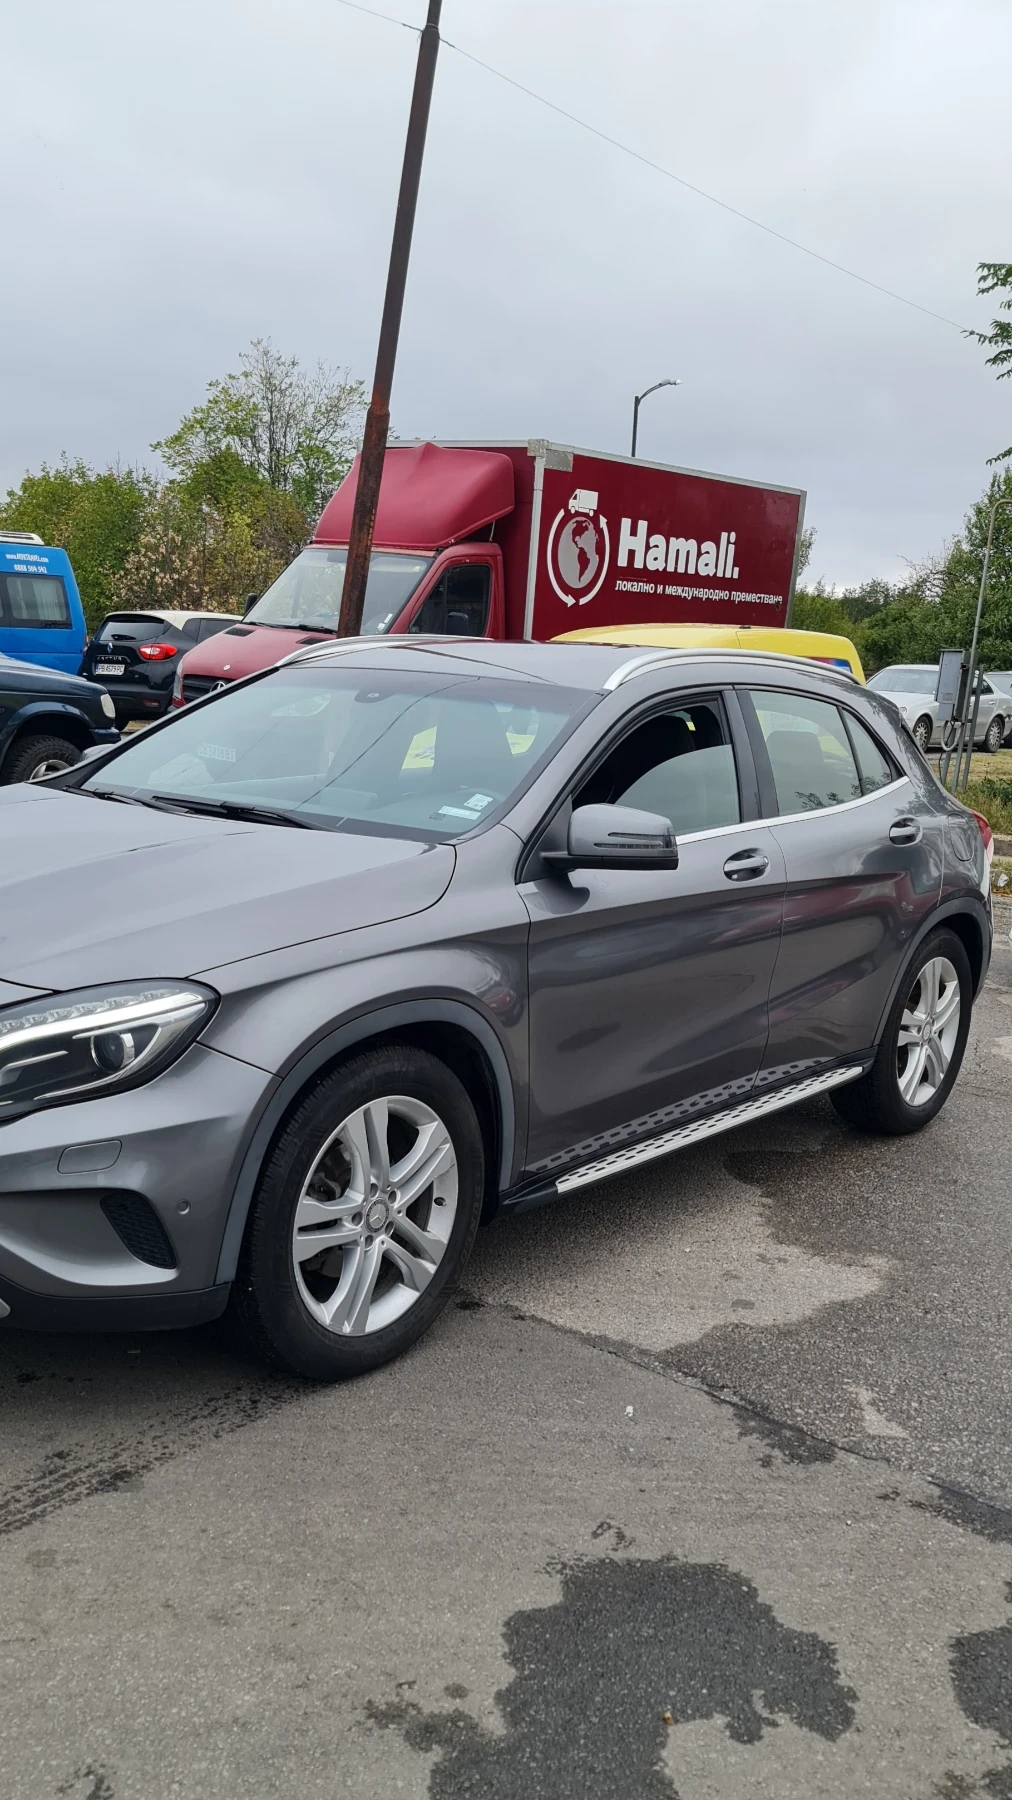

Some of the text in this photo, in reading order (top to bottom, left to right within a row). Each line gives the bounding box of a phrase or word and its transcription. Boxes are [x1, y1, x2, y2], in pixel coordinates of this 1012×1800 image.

[617, 518, 739, 579] Hamali.
[615, 580, 783, 605] локално и международно преместване
